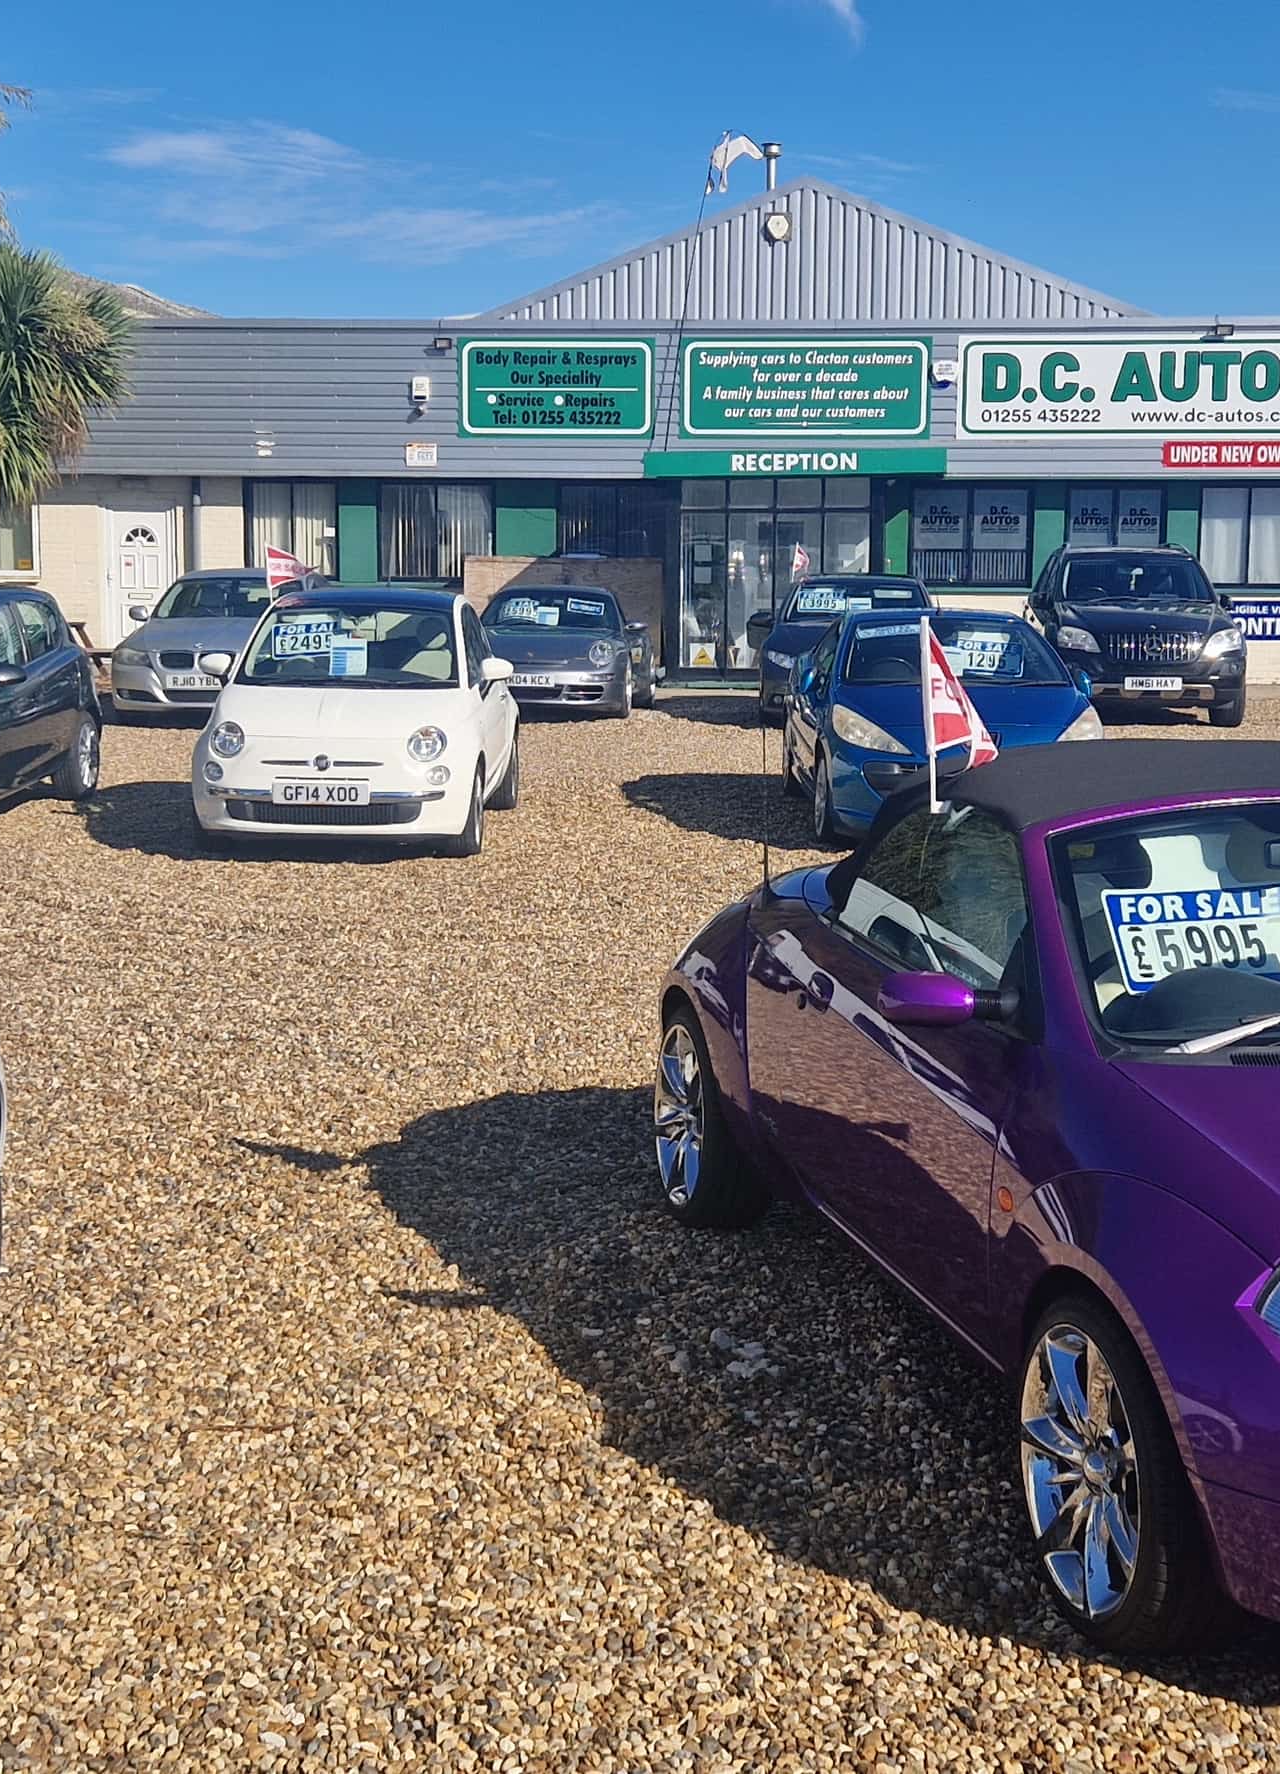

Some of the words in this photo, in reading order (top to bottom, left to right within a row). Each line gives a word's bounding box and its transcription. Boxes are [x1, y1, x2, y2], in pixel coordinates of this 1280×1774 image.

[476, 351, 509, 367] Body
[513, 351, 557, 367] Repair
[562, 352, 570, 365] &
[576, 352, 637, 367] Resprays
[699, 351, 758, 368] Supplying
[761, 355, 785, 365] cars
[789, 352, 802, 365] to
[805, 351, 849, 365] Clacton
[852, 353, 913, 365] customers
[511, 371, 534, 385] Our
[538, 370, 602, 387] Speciality
[752, 368, 770, 384] for
[774, 372, 802, 383] over
[804, 372, 812, 383] a
[815, 368, 858, 383] decade
[981, 351, 1096, 403] D.C.
[498, 393, 545, 406] Service
[565, 393, 615, 409] Repairs
[703, 386, 712, 399] A
[715, 386, 753, 402] family
[755, 386, 807, 400] business
[811, 386, 836, 400] that
[838, 390, 869, 400] cares
[873, 386, 909, 400] about
[492, 410, 517, 424] Tel:
[522, 410, 564, 425] 01255
[569, 410, 621, 425] 435222
[724, 407, 745, 418] our
[748, 407, 772, 418] cars
[775, 404, 799, 418] and
[802, 407, 822, 418] our
[825, 405, 886, 418] customers
[981, 409, 1032, 423] 01255
[1037, 408, 1101, 423] 435222
[1171, 445, 1218, 463] UNDER
[1221, 445, 1254, 463] NEW
[731, 453, 858, 472] RECEPTION
[920, 516, 960, 525] AUTOS
[981, 516, 1020, 525] AUTOS
[1073, 517, 1109, 526] AUTOS
[1121, 517, 1158, 526] AUTOS
[1227, 606, 1268, 615] IGIBLE
[280, 624, 306, 635] FOR
[958, 640, 982, 651] FOR
[283, 786, 320, 801] GF14
[326, 786, 358, 802] XOO
[1119, 895, 1187, 923] FOR
[1197, 886, 1279, 920] SALE
[1128, 923, 1267, 974] £5995
